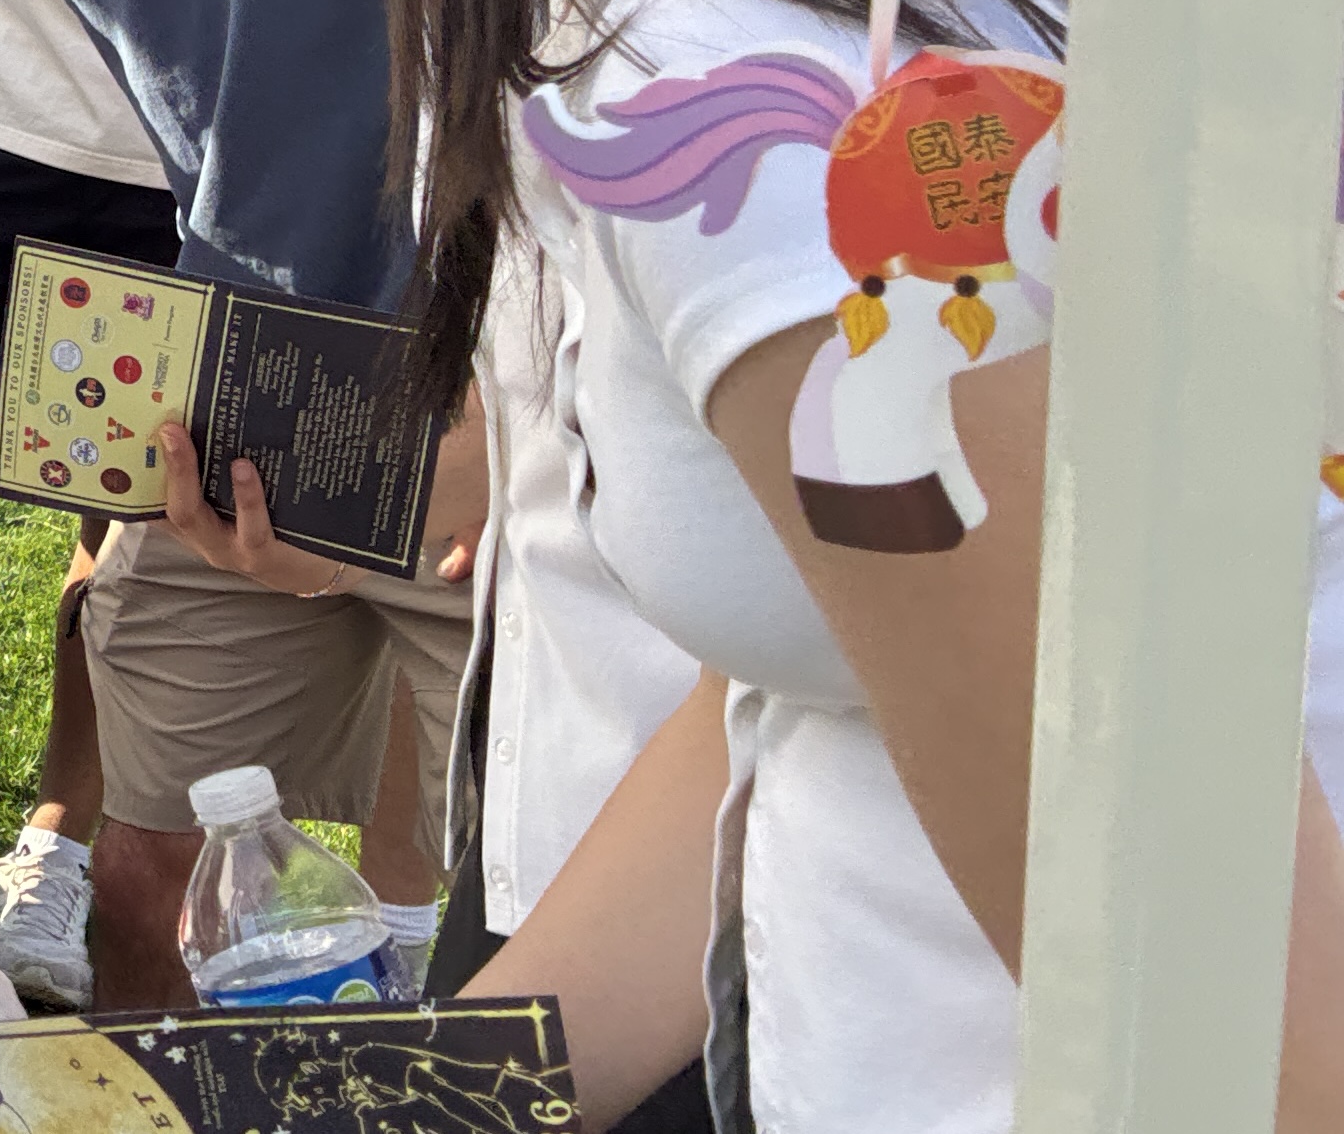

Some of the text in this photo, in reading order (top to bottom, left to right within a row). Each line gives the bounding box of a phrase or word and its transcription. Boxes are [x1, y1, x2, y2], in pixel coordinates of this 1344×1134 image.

[906, 114, 1015, 174] 國泰
[4, 266, 33, 470] THANK YOU TO OUR SPONSORS!
[210, 312, 243, 498] AND TO THE PEOPLE THAT MAKE IT
[229, 386, 242, 429] HAPPEN
